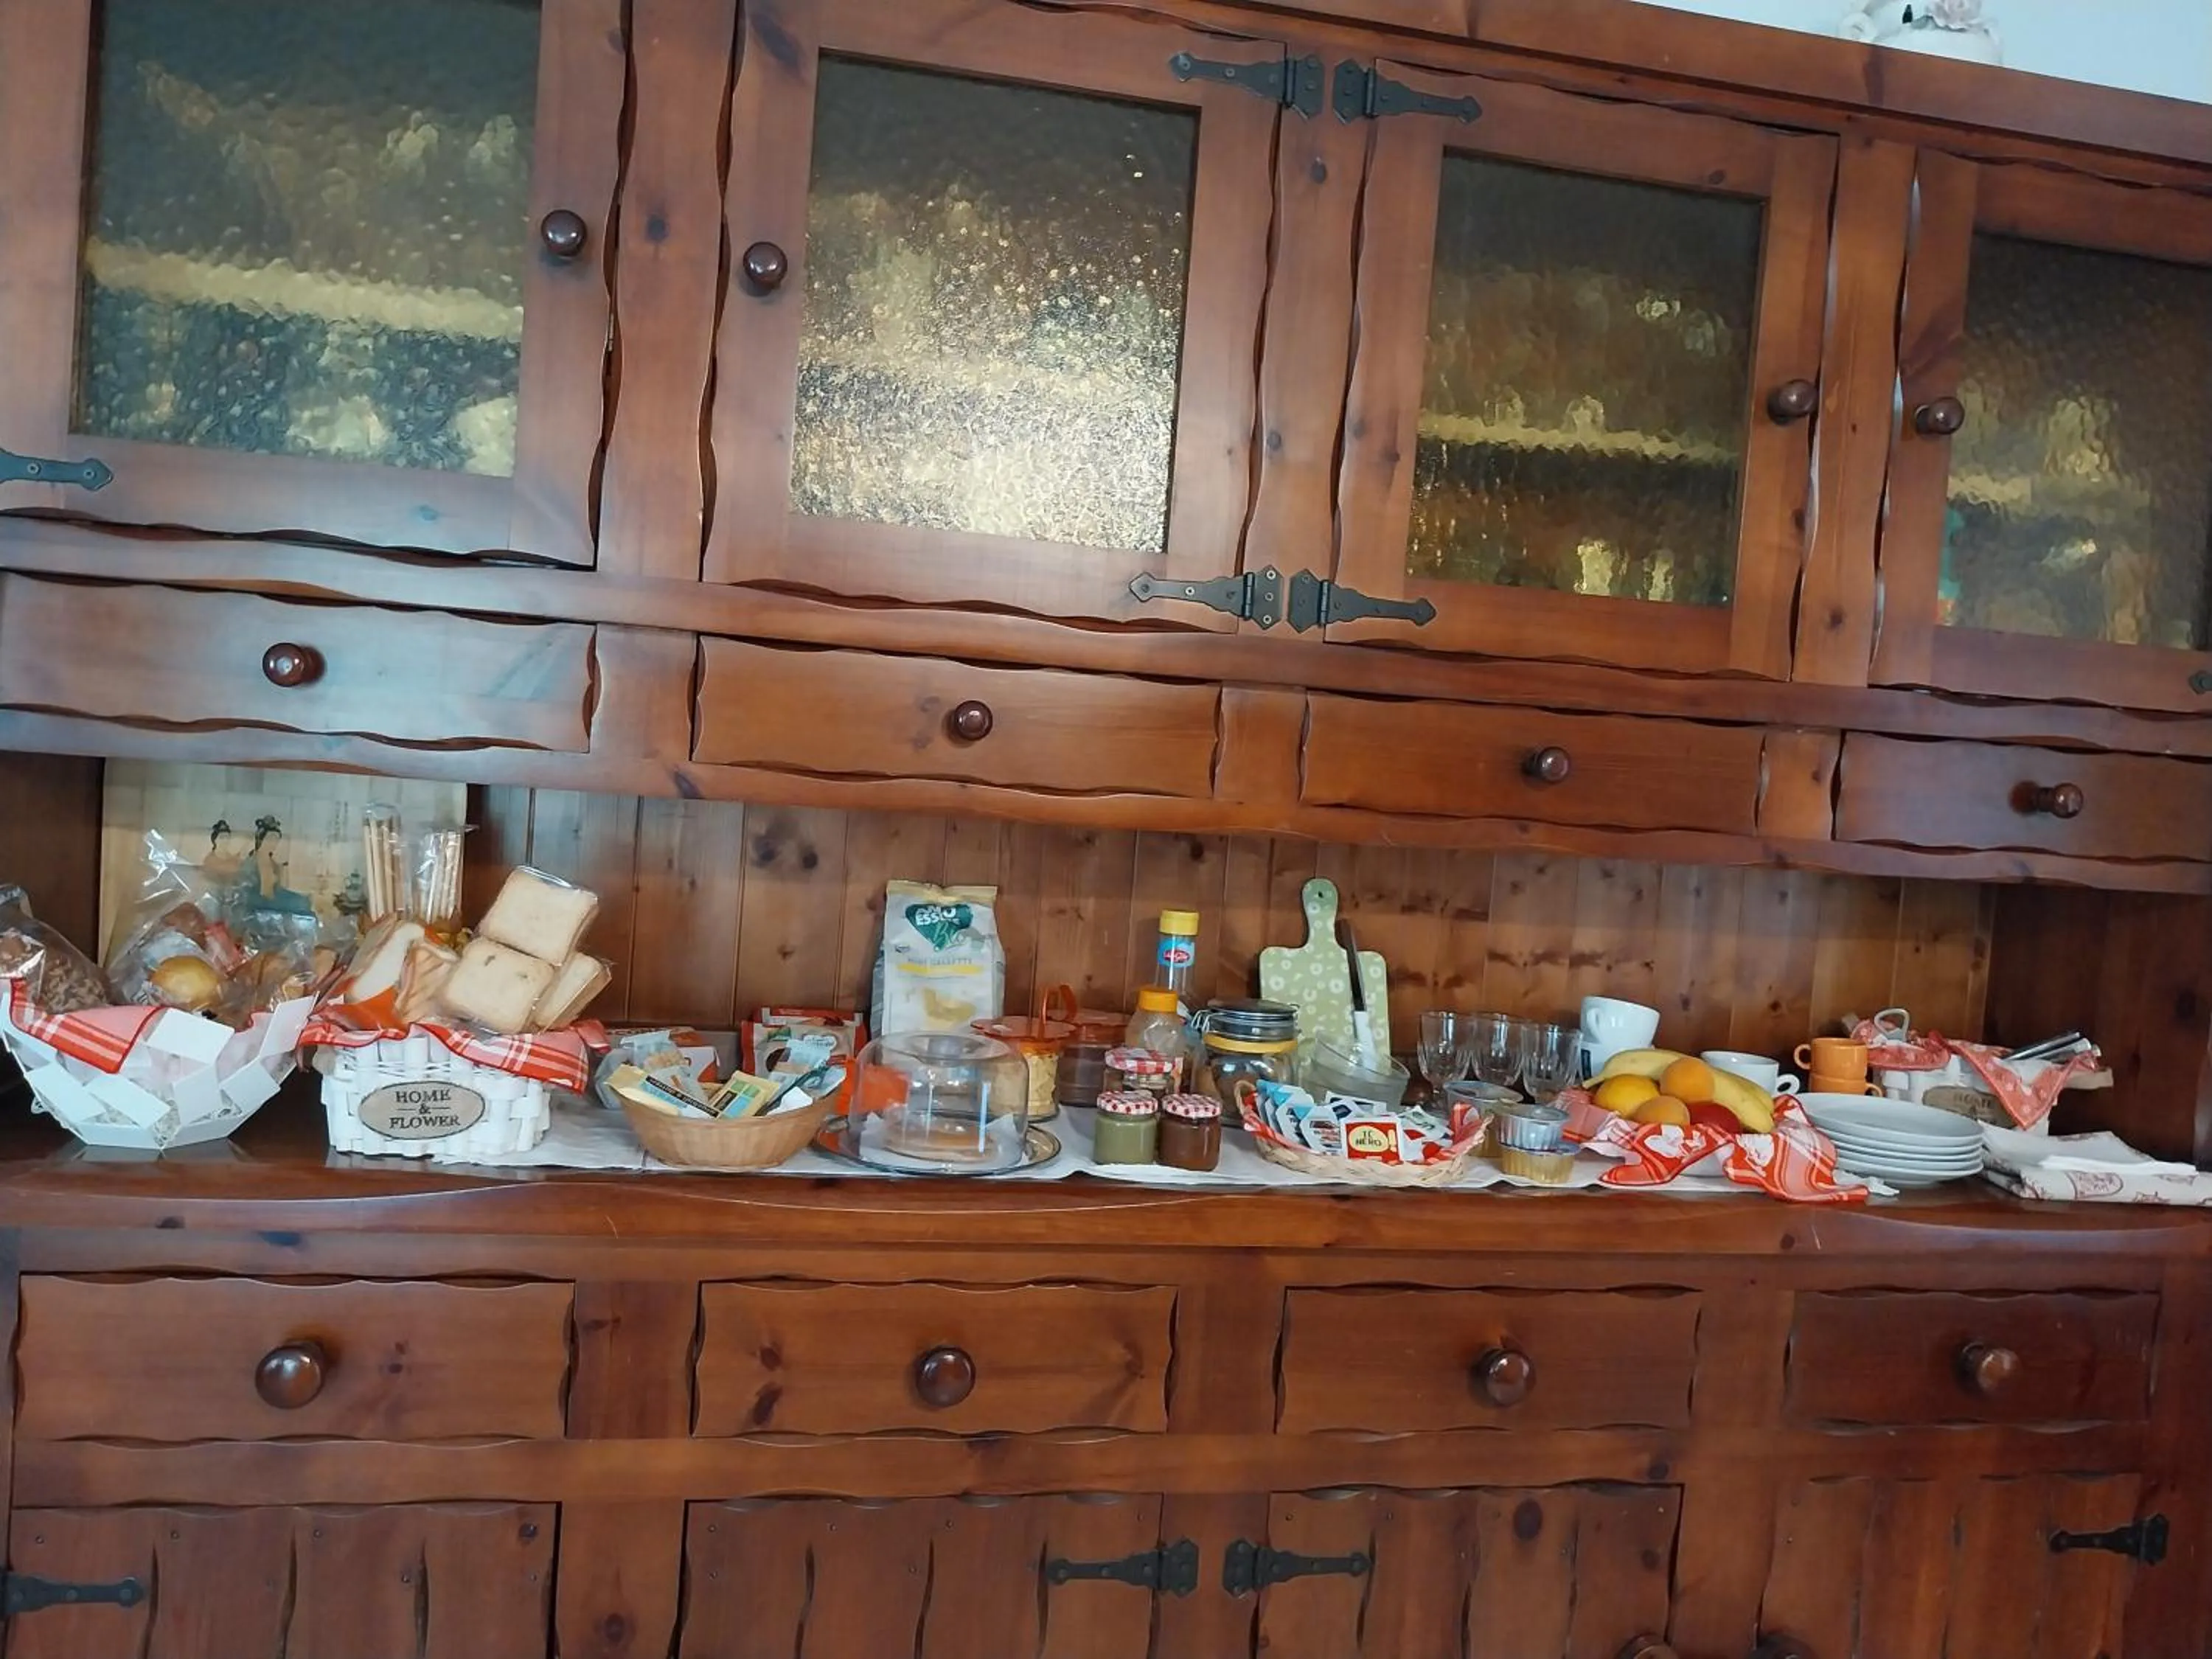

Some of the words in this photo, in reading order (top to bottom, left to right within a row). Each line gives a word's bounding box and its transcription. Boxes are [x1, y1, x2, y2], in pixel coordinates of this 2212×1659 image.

[394, 1089, 451, 1104] HOME
[418, 1103, 431, 1115] &
[389, 1114, 461, 1130] FLOWER
